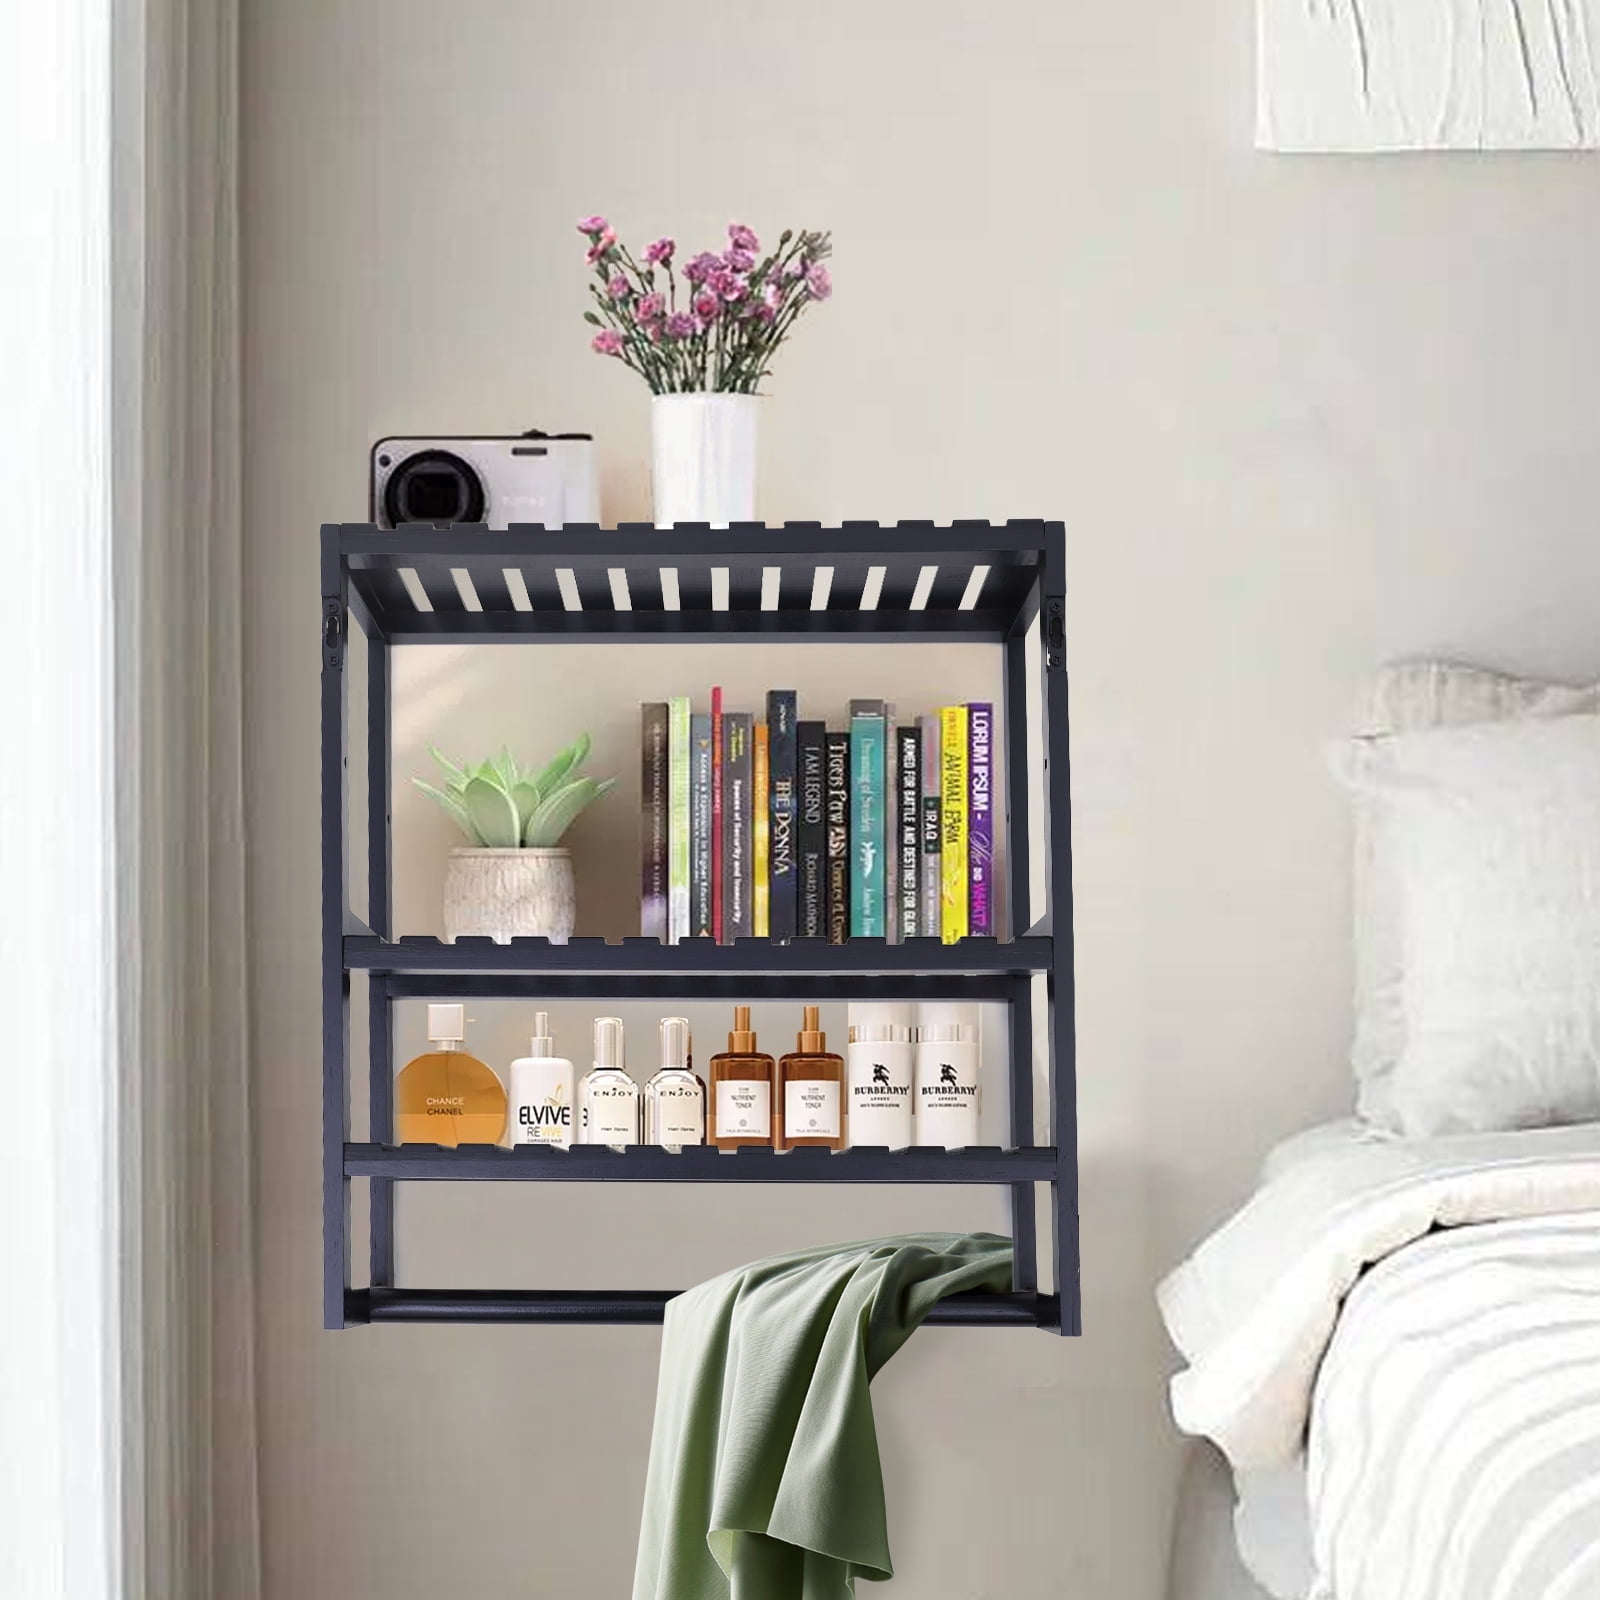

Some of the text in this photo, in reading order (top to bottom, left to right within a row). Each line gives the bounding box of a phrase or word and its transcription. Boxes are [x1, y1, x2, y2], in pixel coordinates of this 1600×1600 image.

[972, 711, 988, 763] LORUM
[805, 754, 820, 773] AM
[903, 738, 915, 768] ARMED
[903, 770, 915, 788] FOR
[972, 765, 988, 811] IPSUM
[732, 779, 742, 810] Spaces
[805, 777, 820, 823] LEGEND
[903, 790, 915, 822] BATTLE
[944, 752, 961, 844] ANIMAL FARM
[774, 777, 792, 874] THE DONNA
[903, 826, 915, 844] AND
[925, 810, 938, 840] IRAQ
[806, 853, 818, 891] RICHARD
[903, 847, 915, 888] DESTINED
[903, 891, 915, 908] FOR
[973, 883, 988, 927] WHAT?
[426, 1097, 464, 1105] CHANCE
[593, 1089, 634, 1097] ENJOY
[660, 1089, 700, 1097] ENJOY
[854, 1086, 909, 1095] BURBERRY
[921, 1086, 977, 1095] BURBERRY
[519, 1105, 570, 1126] ELVIVE
